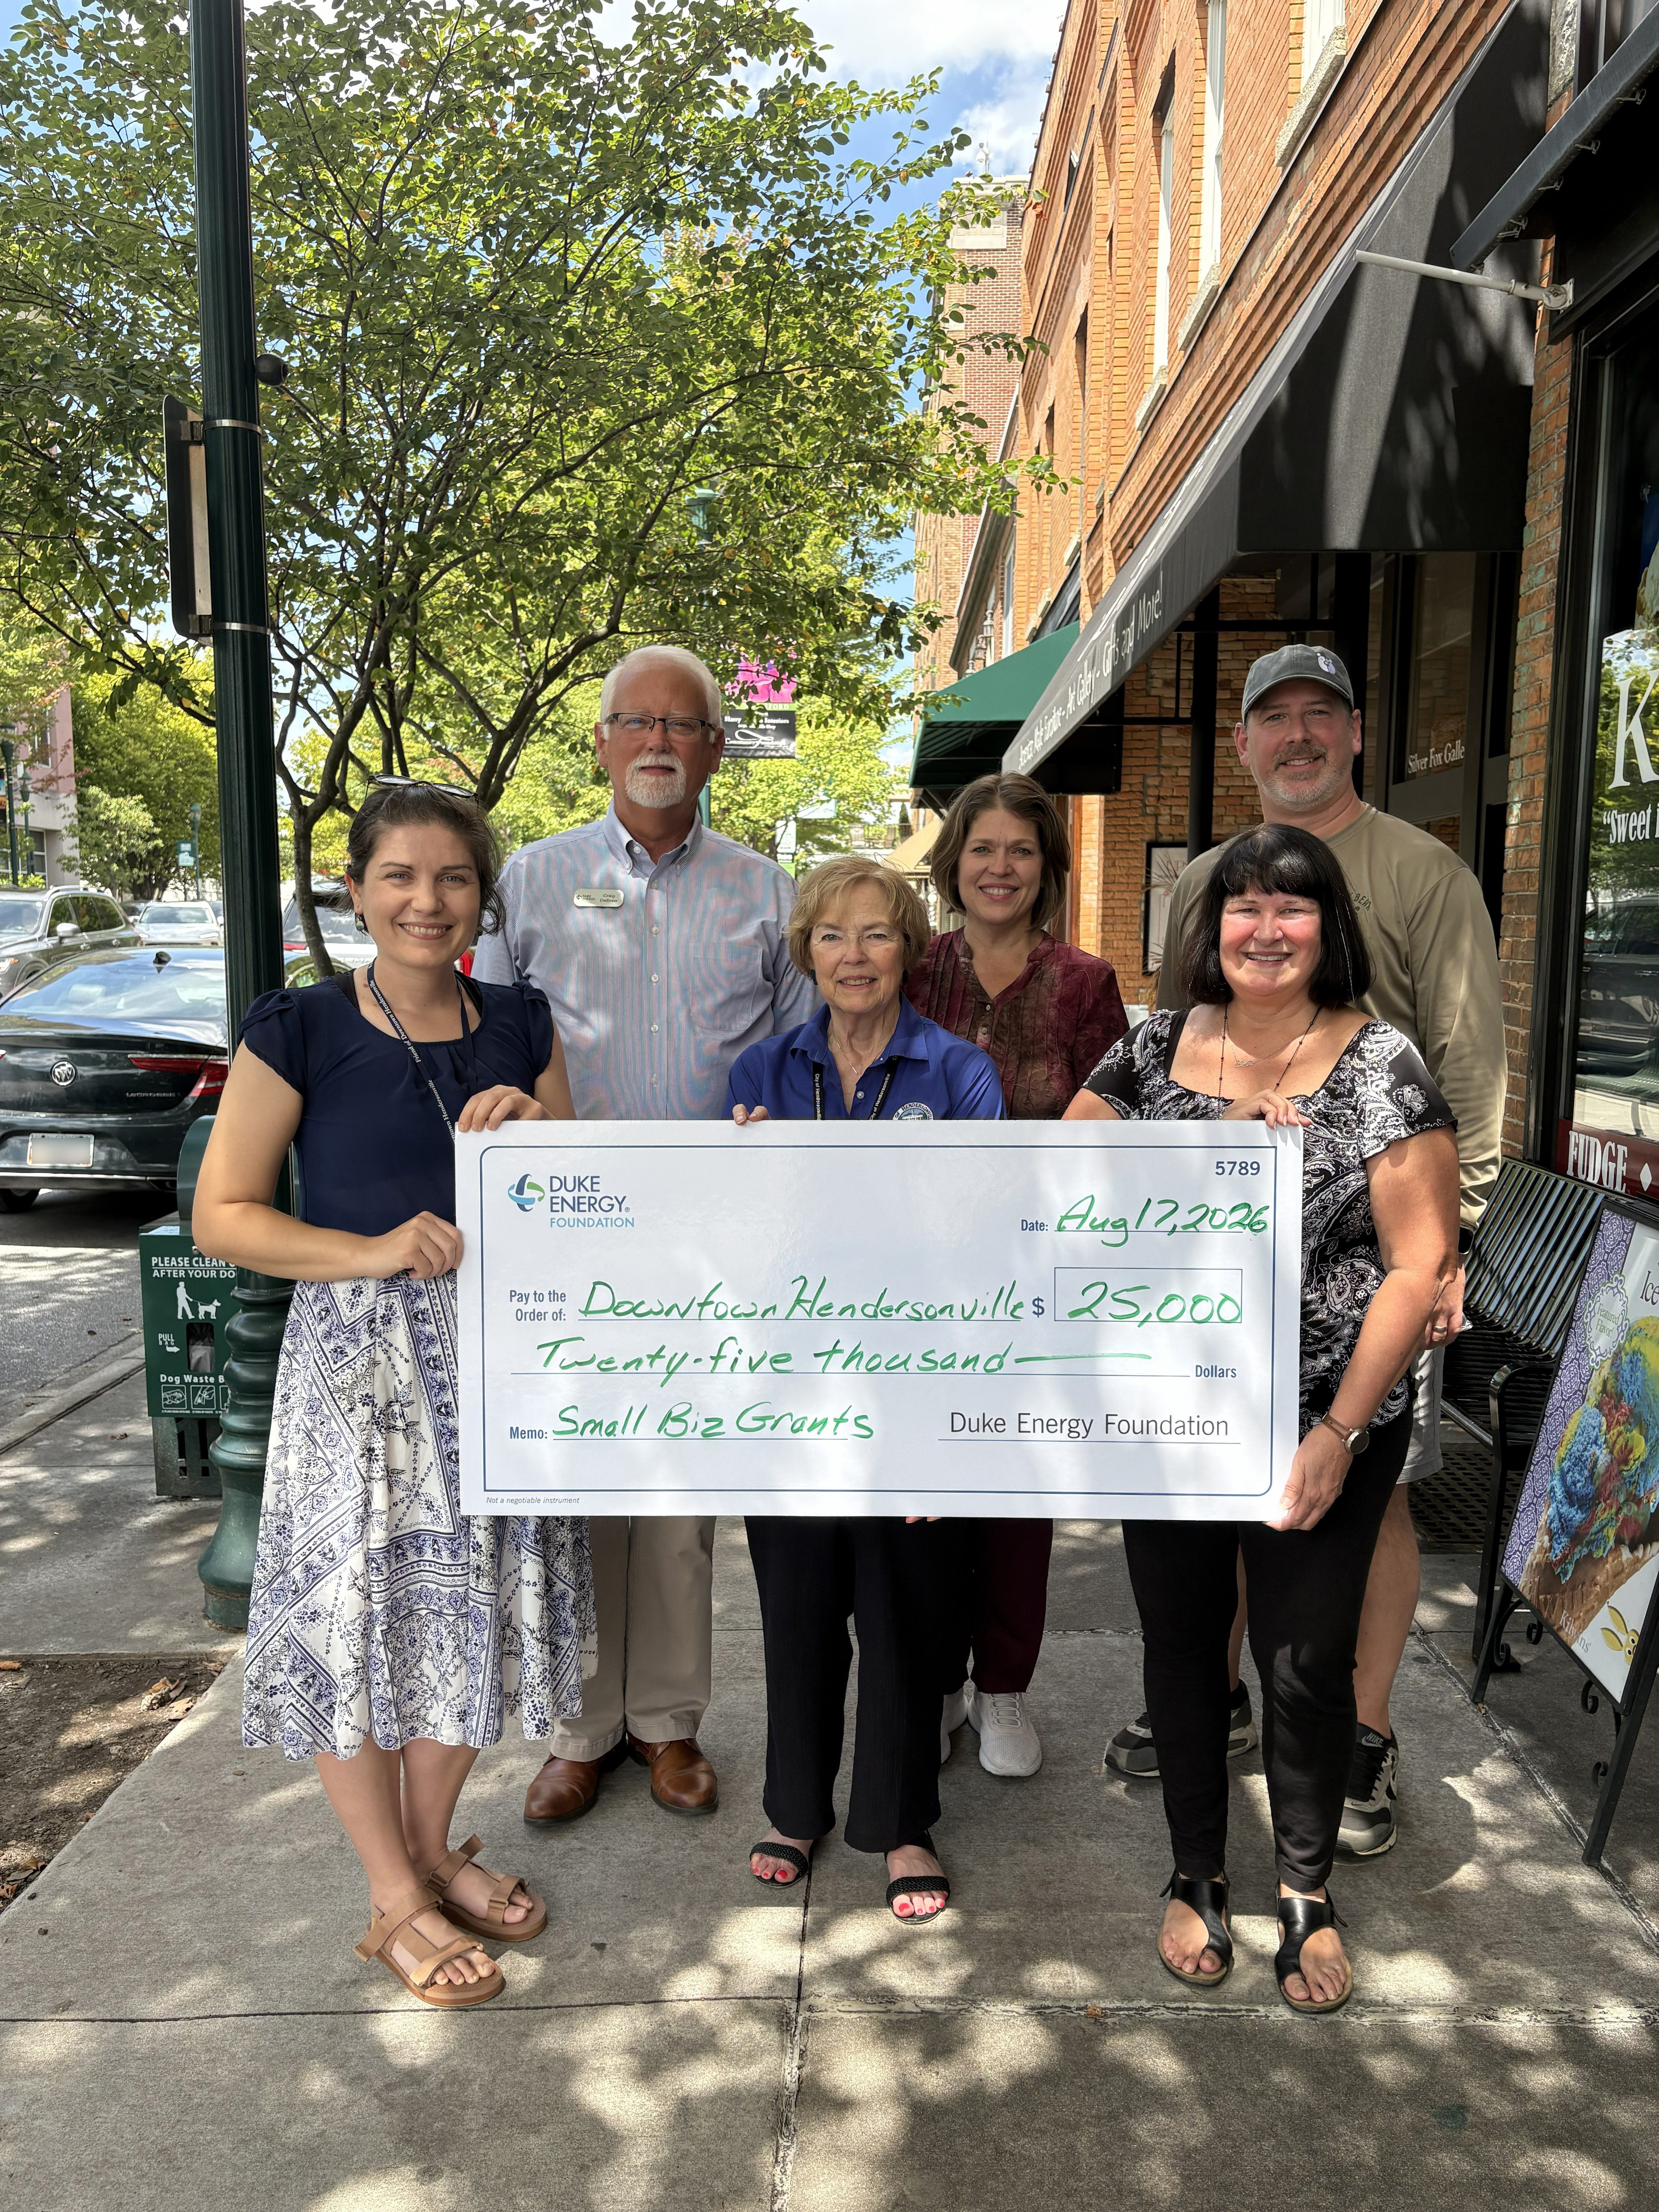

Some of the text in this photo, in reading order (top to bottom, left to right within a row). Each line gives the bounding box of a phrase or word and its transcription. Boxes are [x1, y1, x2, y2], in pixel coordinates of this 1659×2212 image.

[1121, 604, 1135, 658] and
[1137, 570, 1163, 640] More!
[1408, 753, 1429, 774] Silver
[1429, 748, 1443, 768] Fox
[1353, 893, 1371, 911] BEAR
[369, 979, 391, 1015] Hendersonville
[390, 1014, 407, 1040] Downtown
[408, 1046, 421, 1063] Friend
[875, 1074, 891, 1105] Hendersonville
[428, 1080, 449, 1121] Hendersonville
[902, 1103, 933, 1120] HENDERSONVILL
[1215, 1161, 1260, 1176] 5789
[1567, 1130, 1628, 1193] FUDGE
[550, 1176, 600, 1192] DUKE
[550, 1217, 634, 1228] FOUNDATION
[1021, 1219, 1048, 1231] Date:
[1056, 1194, 1128, 1247] Aug
[151, 1257, 190, 1267] PLEASE
[192, 1257, 226, 1267] CLEAN
[153, 1269, 235, 1278] AFTER YOUR DO
[510, 1290, 566, 1305] Pay to the
[1640, 1271, 1659, 1305] Ice
[579, 1275, 1024, 1322] Downtown Hendersonville
[1032, 1296, 1045, 1318] $
[1067, 1281, 1242, 1328] 25,000
[515, 1308, 566, 1321] Order of:
[1597, 1303, 1620, 1325] Featured
[1596, 1319, 1614, 1338] Flavor!
[537, 1337, 1011, 1388] Twenty-five thousand
[1195, 1365, 1237, 1378] Dollars
[160, 1374, 180, 1384] Dog
[184, 1374, 215, 1383] Waste
[553, 1403, 874, 1439] Small Biz Grants
[951, 1412, 1228, 1438] Duke Energy Foundation
[510, 1426, 548, 1439] Memo:
[506, 1497, 541, 1505] negotiable
[1366, 1733, 1384, 1745] NIKE
